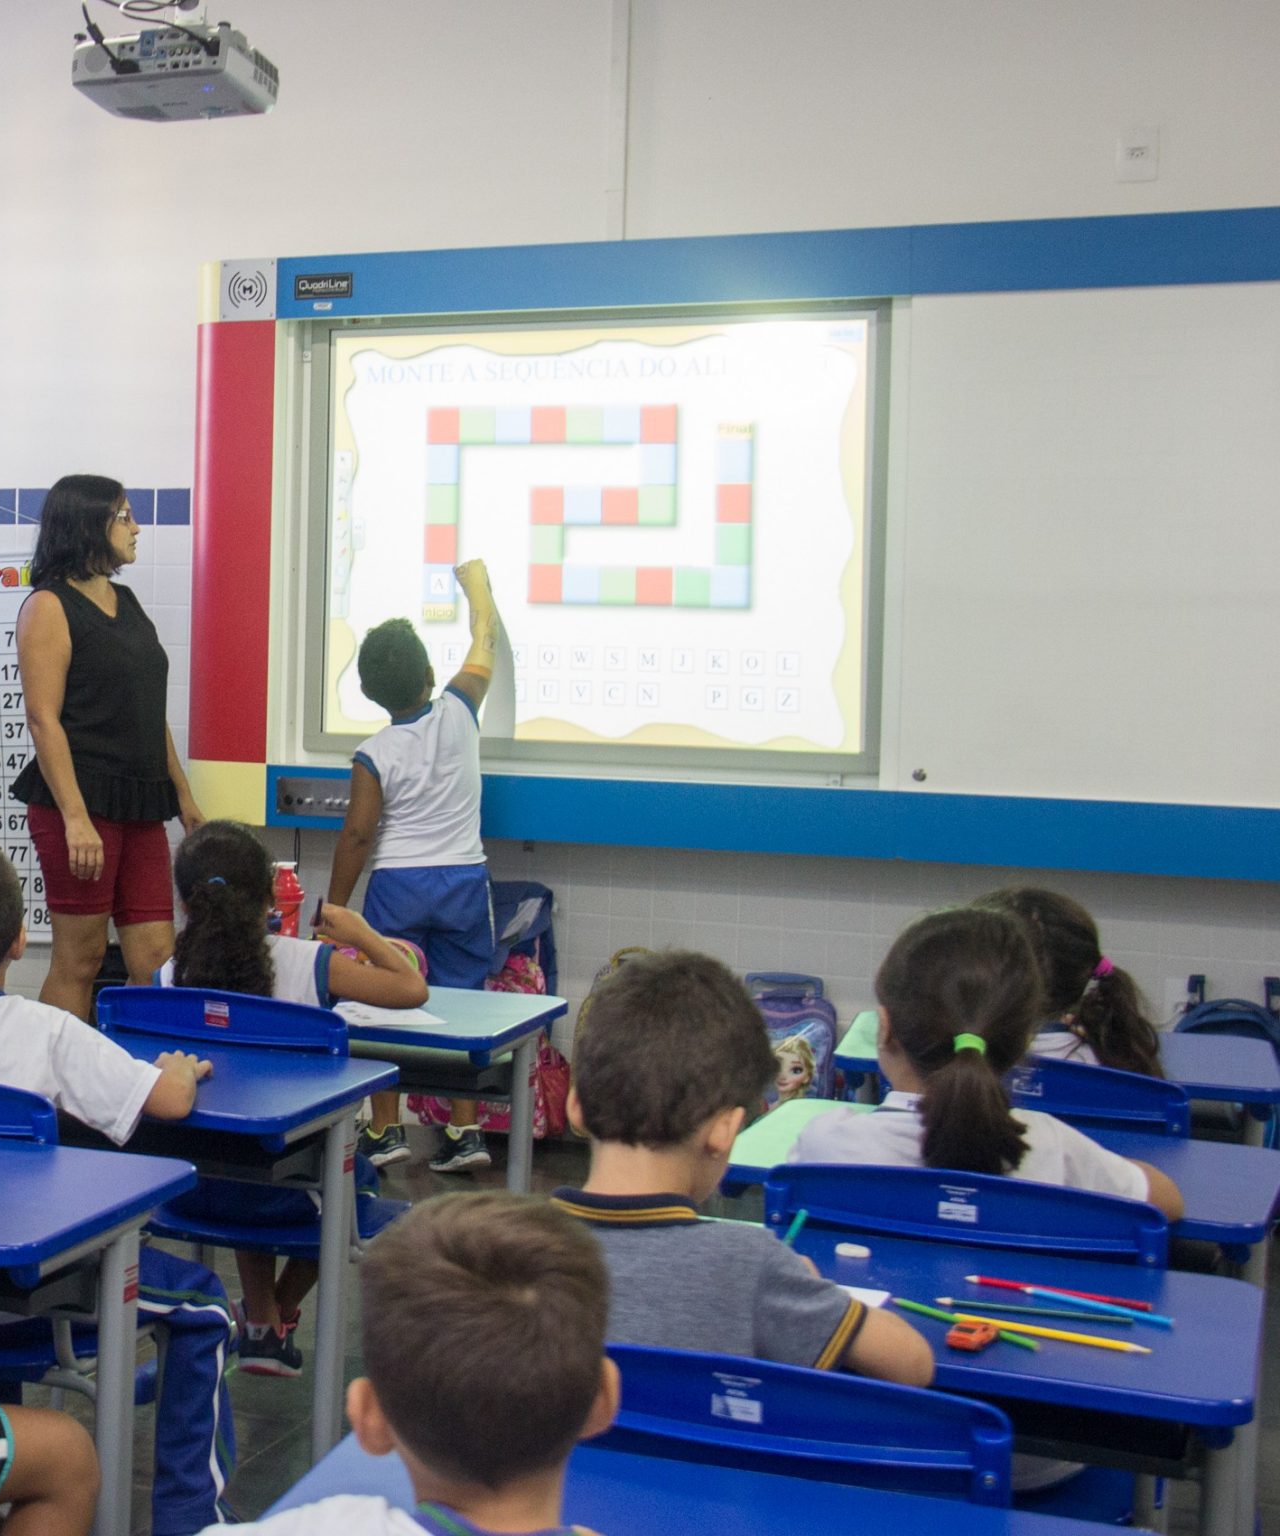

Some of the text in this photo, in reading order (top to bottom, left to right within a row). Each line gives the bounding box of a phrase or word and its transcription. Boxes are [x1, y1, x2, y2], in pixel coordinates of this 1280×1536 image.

[367, 362, 454, 384] MONTE
[462, 363, 477, 383] A
[639, 356, 676, 379] DO
[434, 578, 446, 590] A
[5, 631, 14, 647] 7
[448, 649, 457, 661] E
[543, 650, 554, 665] Q
[573, 651, 589, 663] W
[610, 652, 618, 665] S
[641, 653, 655, 666] M
[679, 654, 686, 667] J
[711, 655, 723, 668] K
[745, 656, 758, 670] O
[783, 657, 792, 671] L
[2, 665, 20, 680] 17
[3, 693, 23, 708] 27
[542, 685, 792, 707] U V C N P G Z
[4, 723, 25, 738] 37
[6, 754, 27, 770] 47
[8, 815, 28, 831] 67
[8, 846, 29, 862] 77
[33, 908, 51, 925] 98
